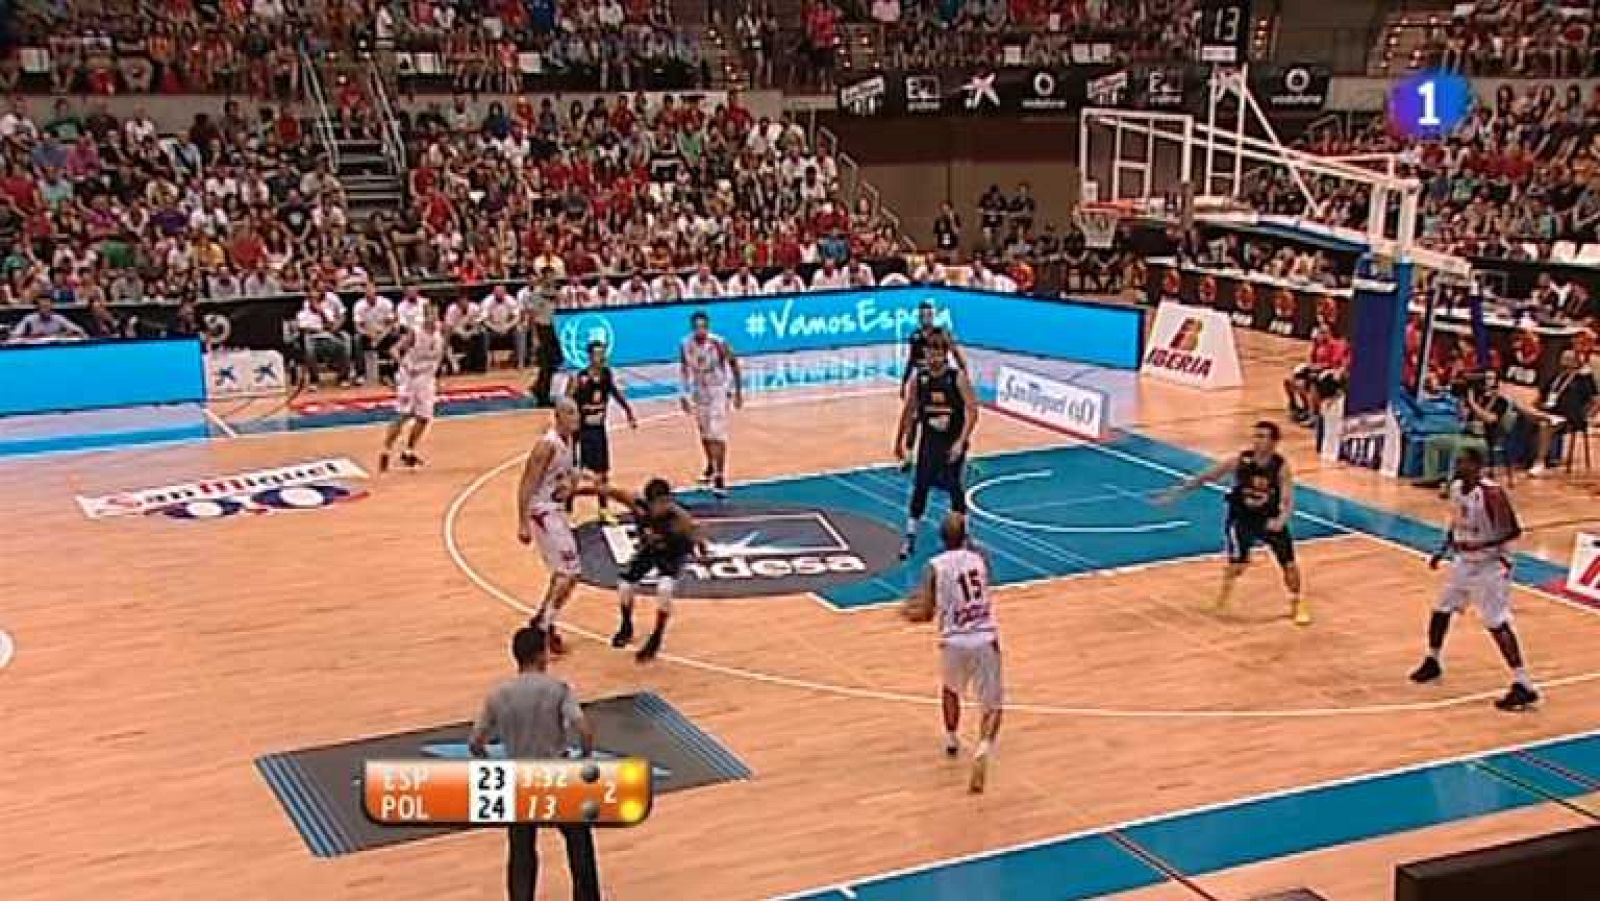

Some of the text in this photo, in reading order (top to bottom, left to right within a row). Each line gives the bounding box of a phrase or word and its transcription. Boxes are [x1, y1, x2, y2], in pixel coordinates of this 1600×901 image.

[1214, 6, 1240, 41] 13
[1146, 348, 1213, 376] IBERIA
[957, 568, 983, 602] 15
